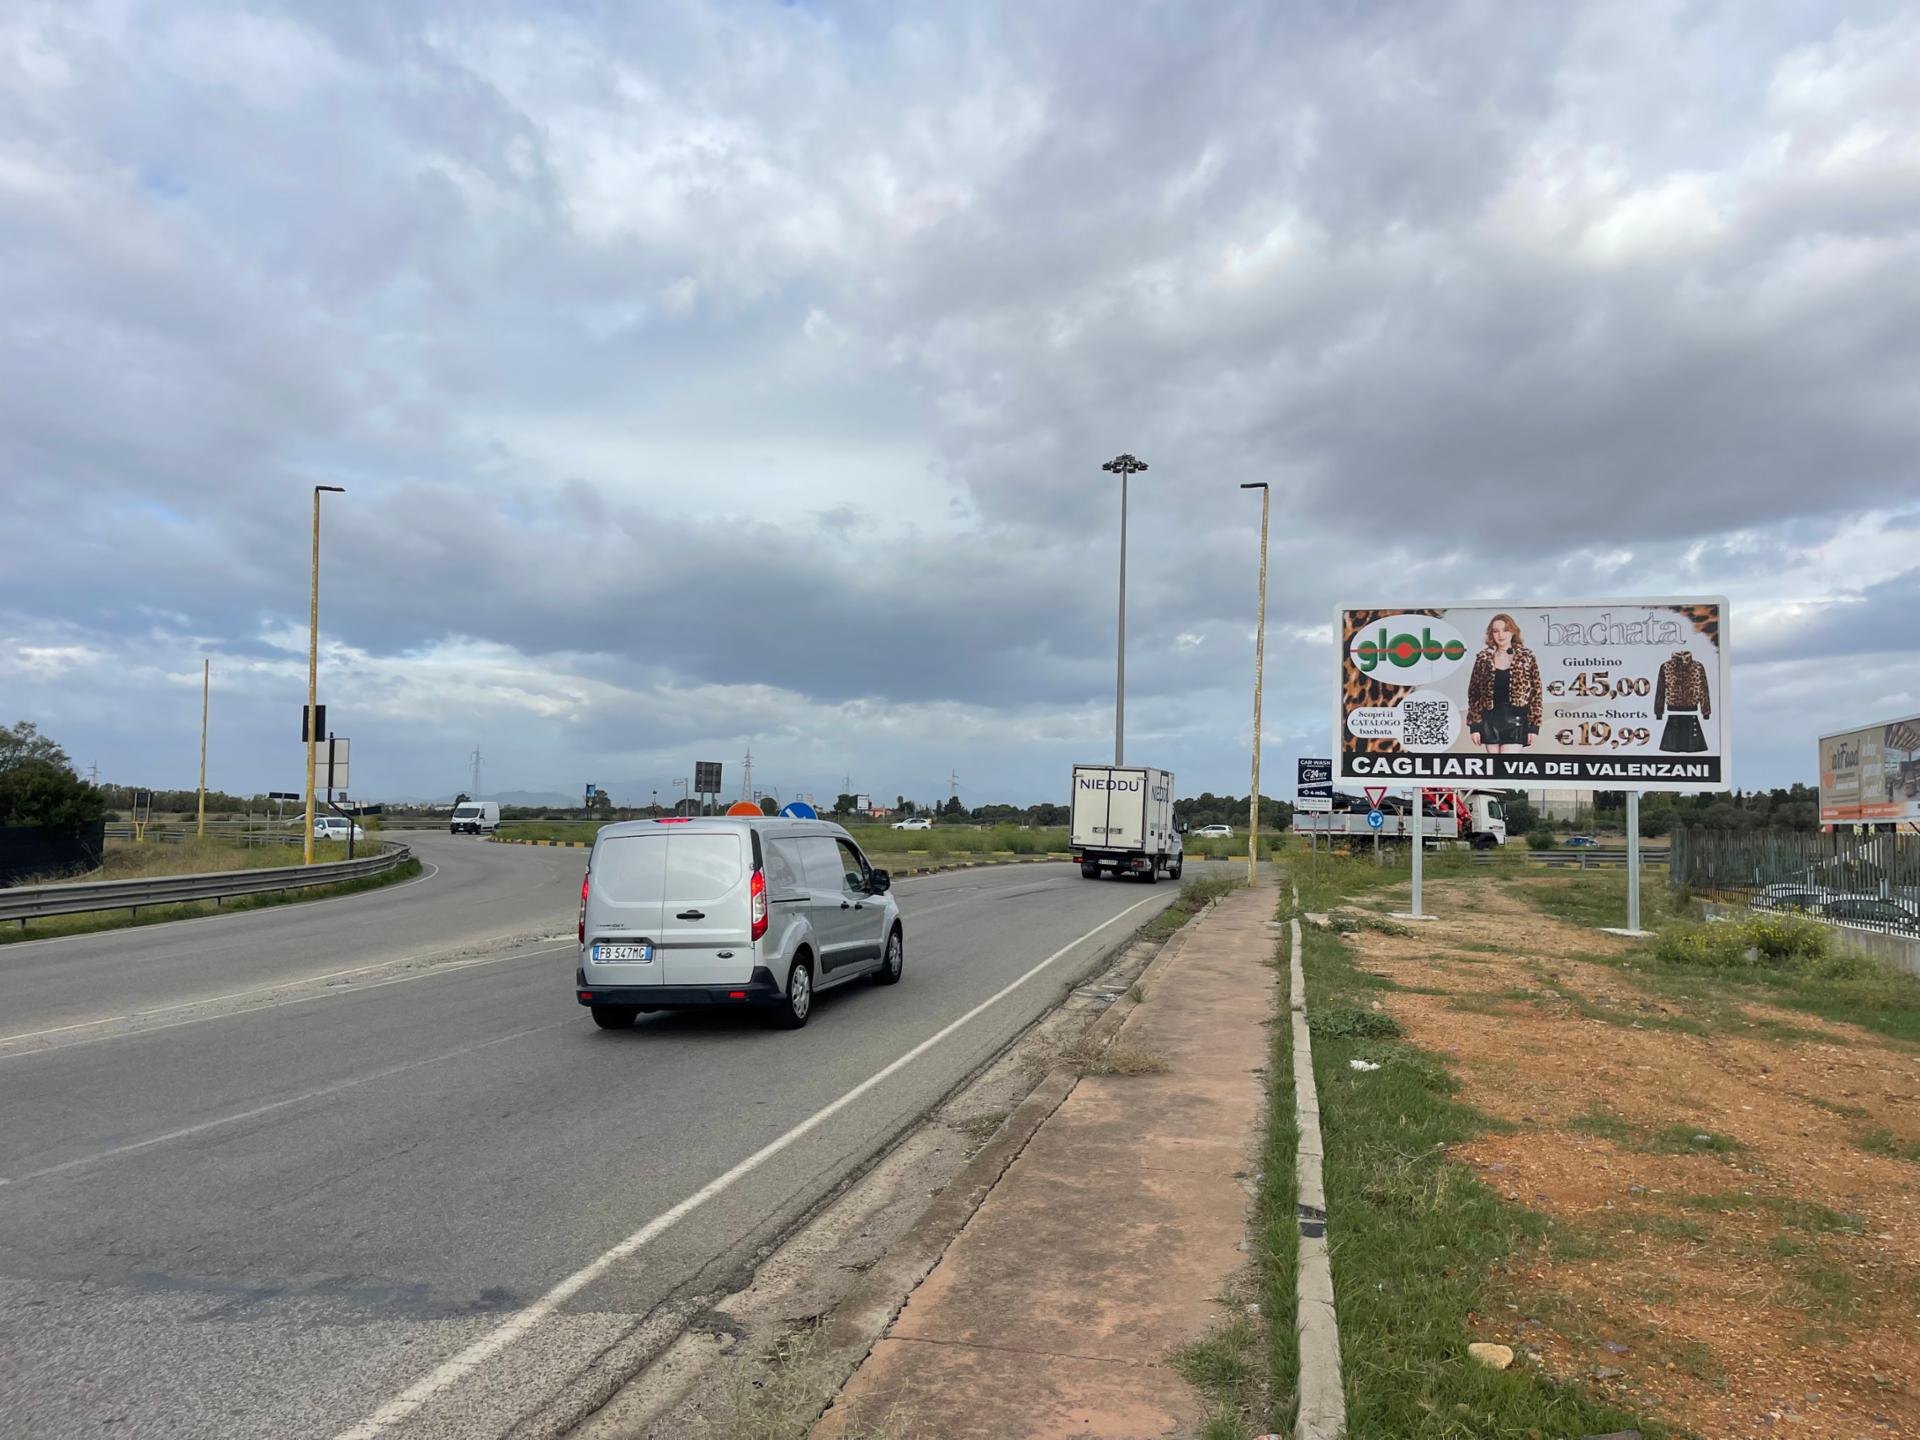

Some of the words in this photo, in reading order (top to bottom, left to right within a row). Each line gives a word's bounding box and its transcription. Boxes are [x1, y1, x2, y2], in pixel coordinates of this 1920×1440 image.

[1540, 611, 1687, 647] bachata
[1357, 627, 1465, 673] globo
[1562, 656, 1623, 667] Giubbino
[1358, 711, 1386, 719] Scopri
[1554, 708, 1648, 719] Gonna-Shorts
[1351, 719, 1401, 727] CATALOGO
[1352, 756, 1493, 776] CAGLIARI
[1503, 761, 1539, 775] VIA
[1545, 762, 1579, 775] DEI
[1586, 763, 1709, 777] VALENZANI
[1080, 779, 1139, 792] NIEDDU
[600, 947, 611, 958] FB
[614, 947, 645, 959] 547MG
